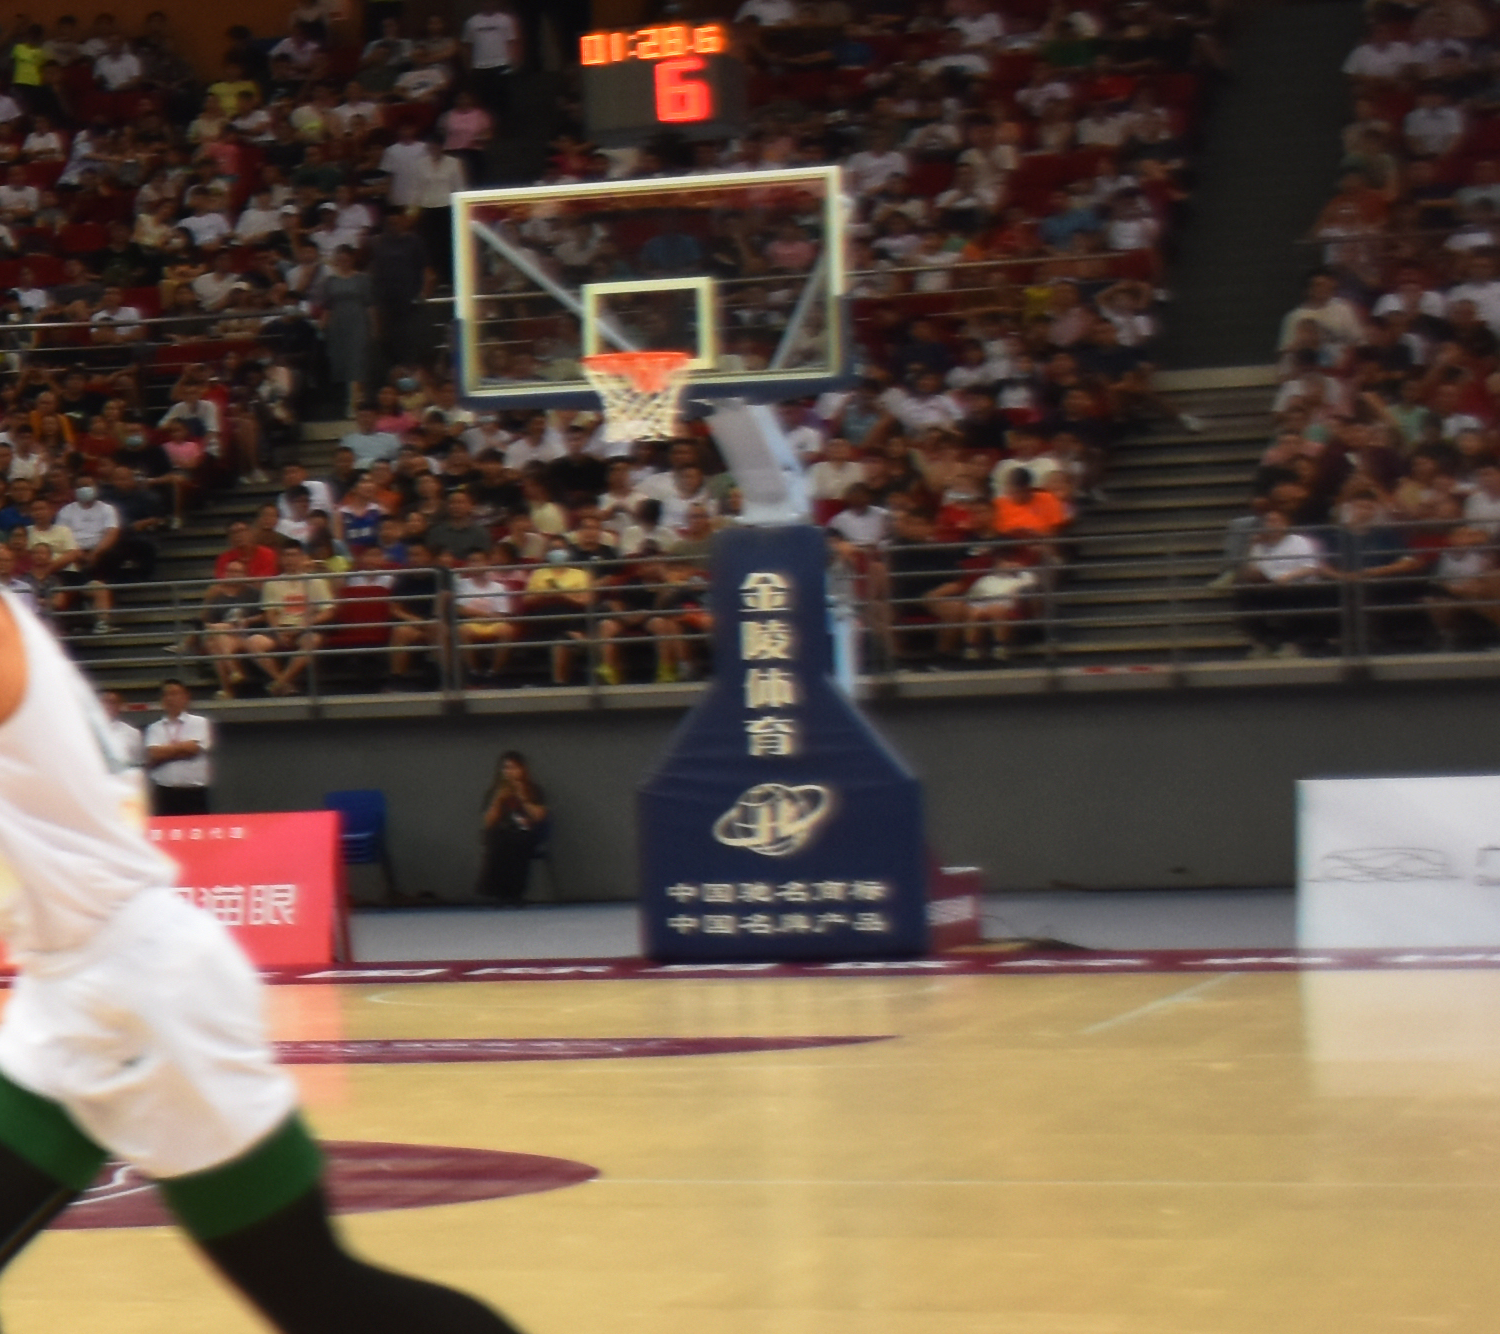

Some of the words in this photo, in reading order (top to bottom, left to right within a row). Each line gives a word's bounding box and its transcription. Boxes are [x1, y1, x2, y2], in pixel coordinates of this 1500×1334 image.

[655, 56, 712, 124] 6
[737, 571, 796, 757] 金陵体育
